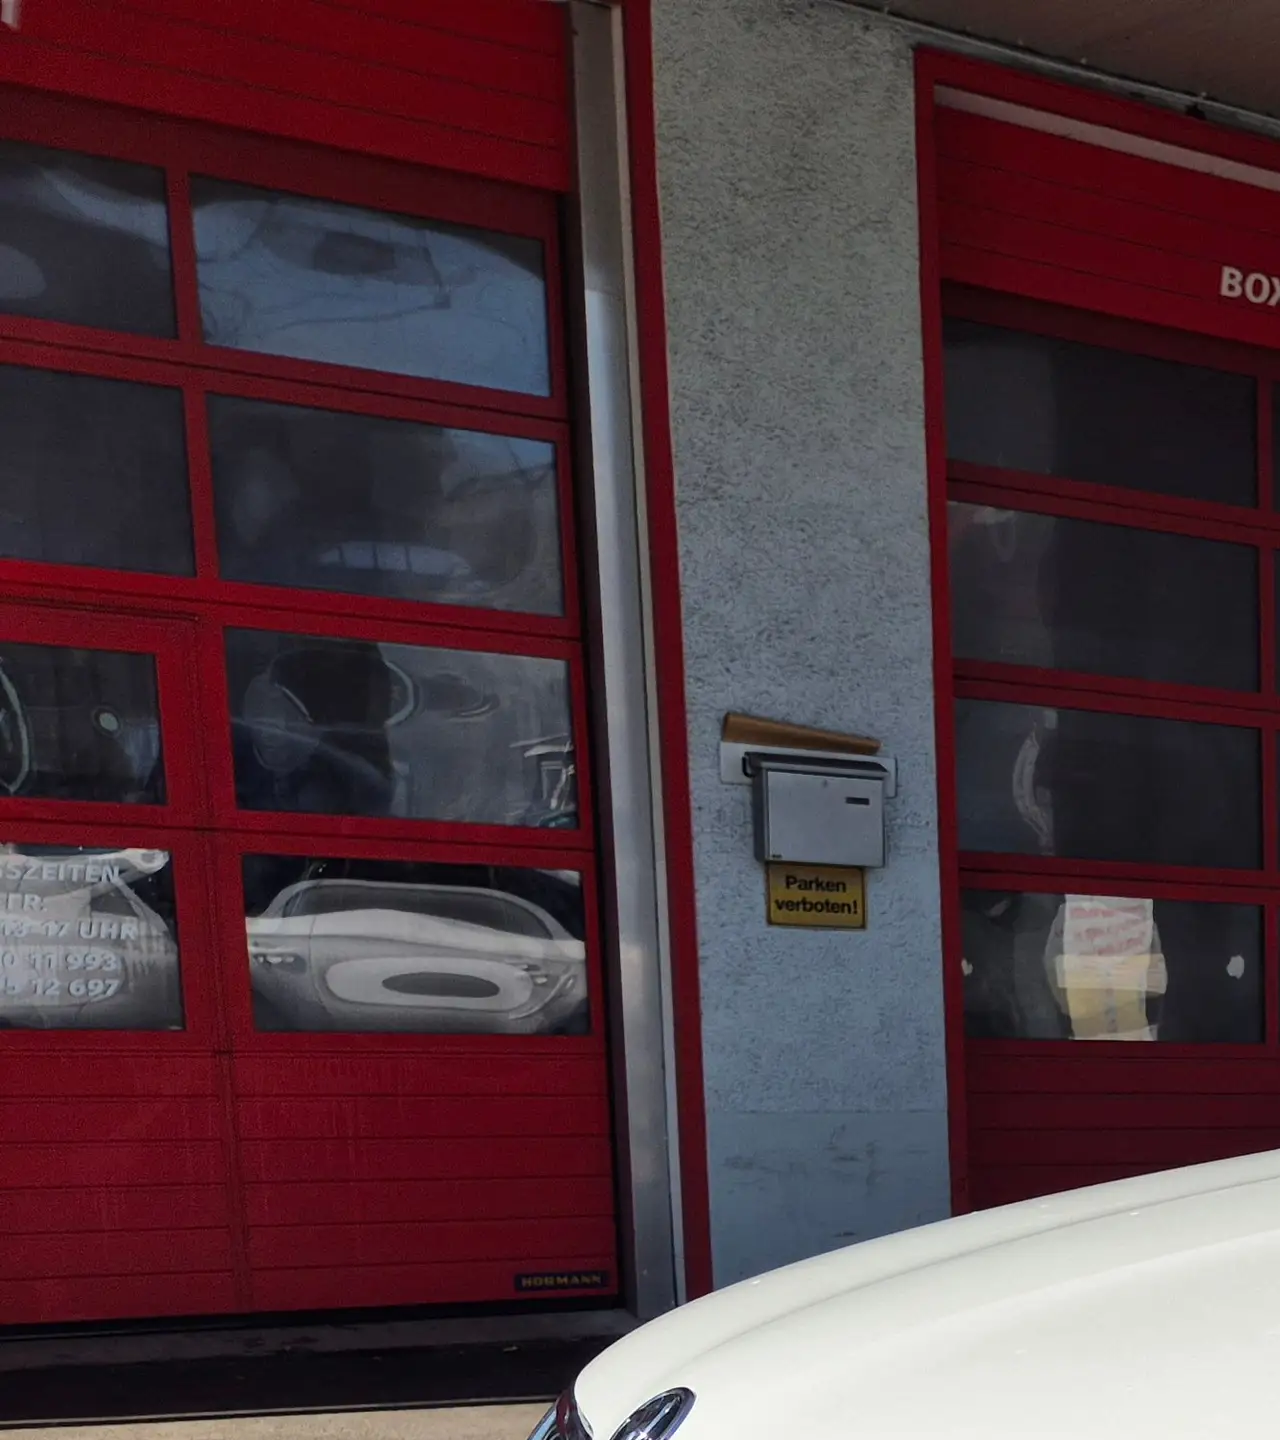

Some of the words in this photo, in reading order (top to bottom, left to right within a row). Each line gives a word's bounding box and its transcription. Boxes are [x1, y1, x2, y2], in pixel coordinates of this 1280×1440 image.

[785, 875, 847, 893] Parken
[775, 896, 858, 914] verboten!
[79, 921, 138, 940] UHR
[66, 953, 119, 972] 993
[68, 979, 120, 998] 697
